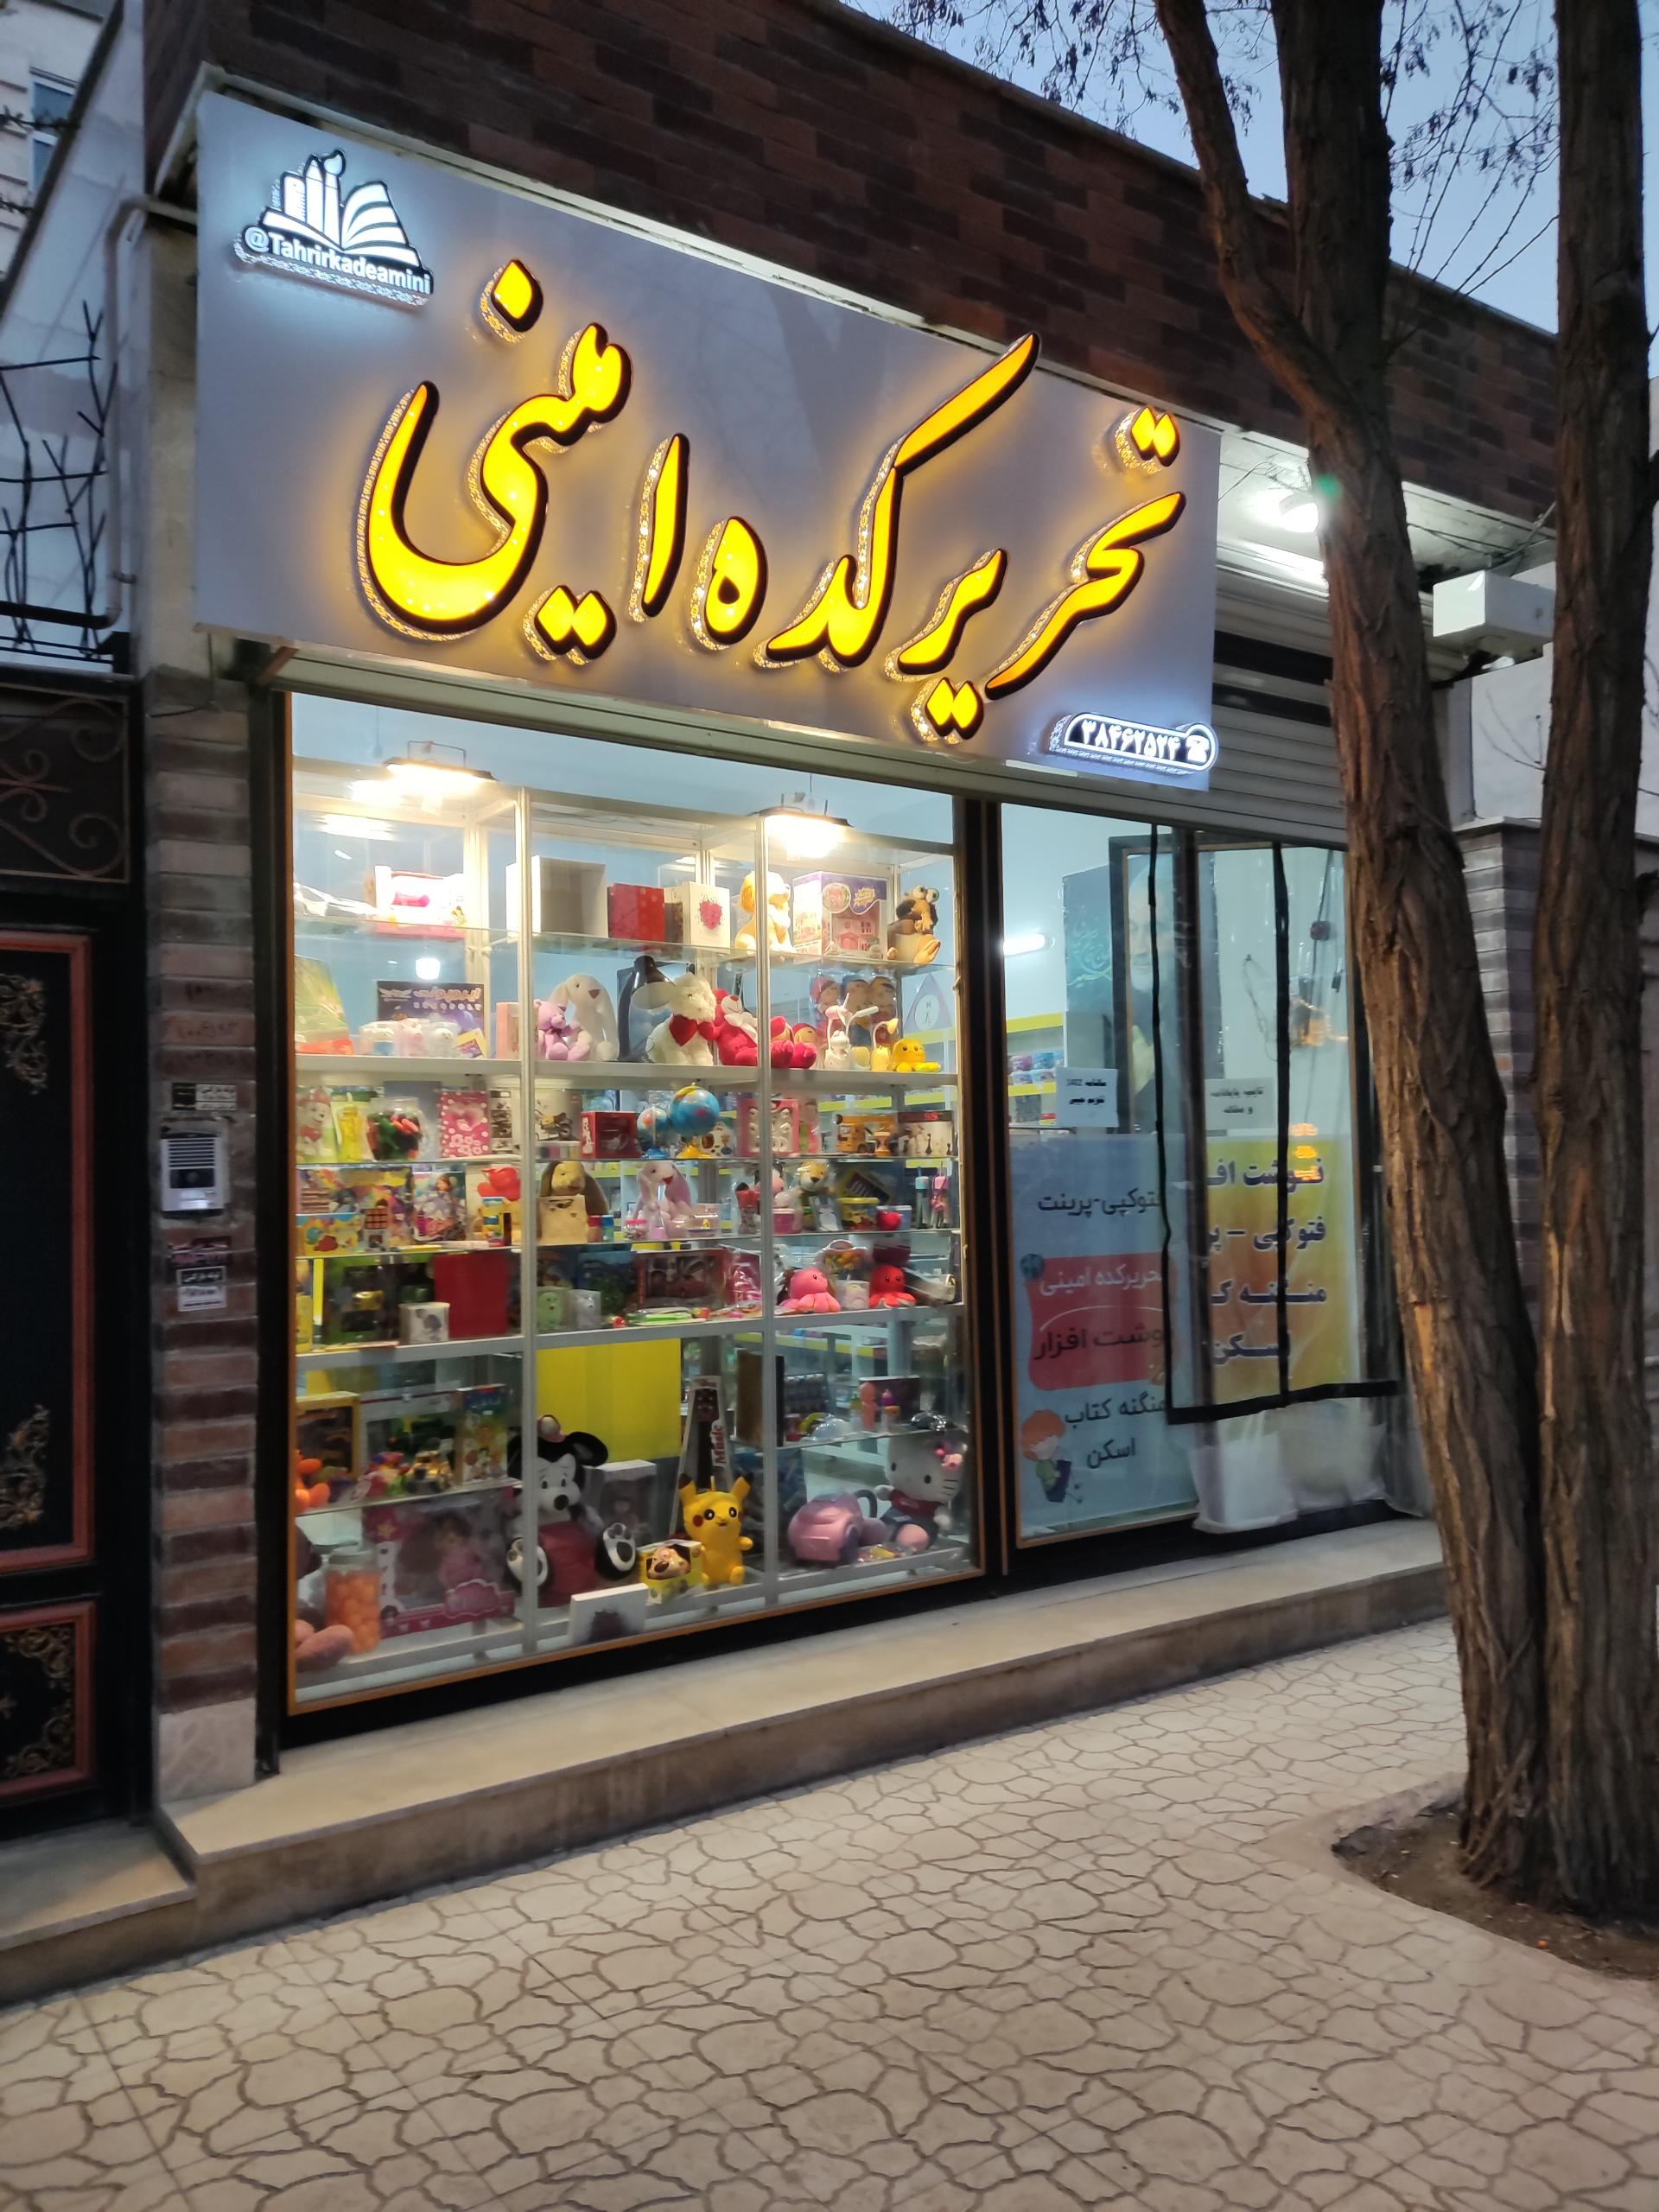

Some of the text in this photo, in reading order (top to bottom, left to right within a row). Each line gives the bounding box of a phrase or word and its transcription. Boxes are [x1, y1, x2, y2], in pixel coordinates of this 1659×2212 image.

[244, 226, 431, 295] @Tahrirkadeamini
[363, 258, 689, 660] امینی
[1038, 1187, 1160, 1218] توکپی-پرینت
[1254, 1216, 1326, 1250] فتوکی
[1039, 1263, 1163, 1296] حریرکده امینی
[1240, 1283, 1327, 1304] مننه
[1033, 1322, 1164, 1361] وشت افزار
[1065, 1397, 1112, 1429] کتاب
[1087, 1437, 1136, 1470] اسکن
